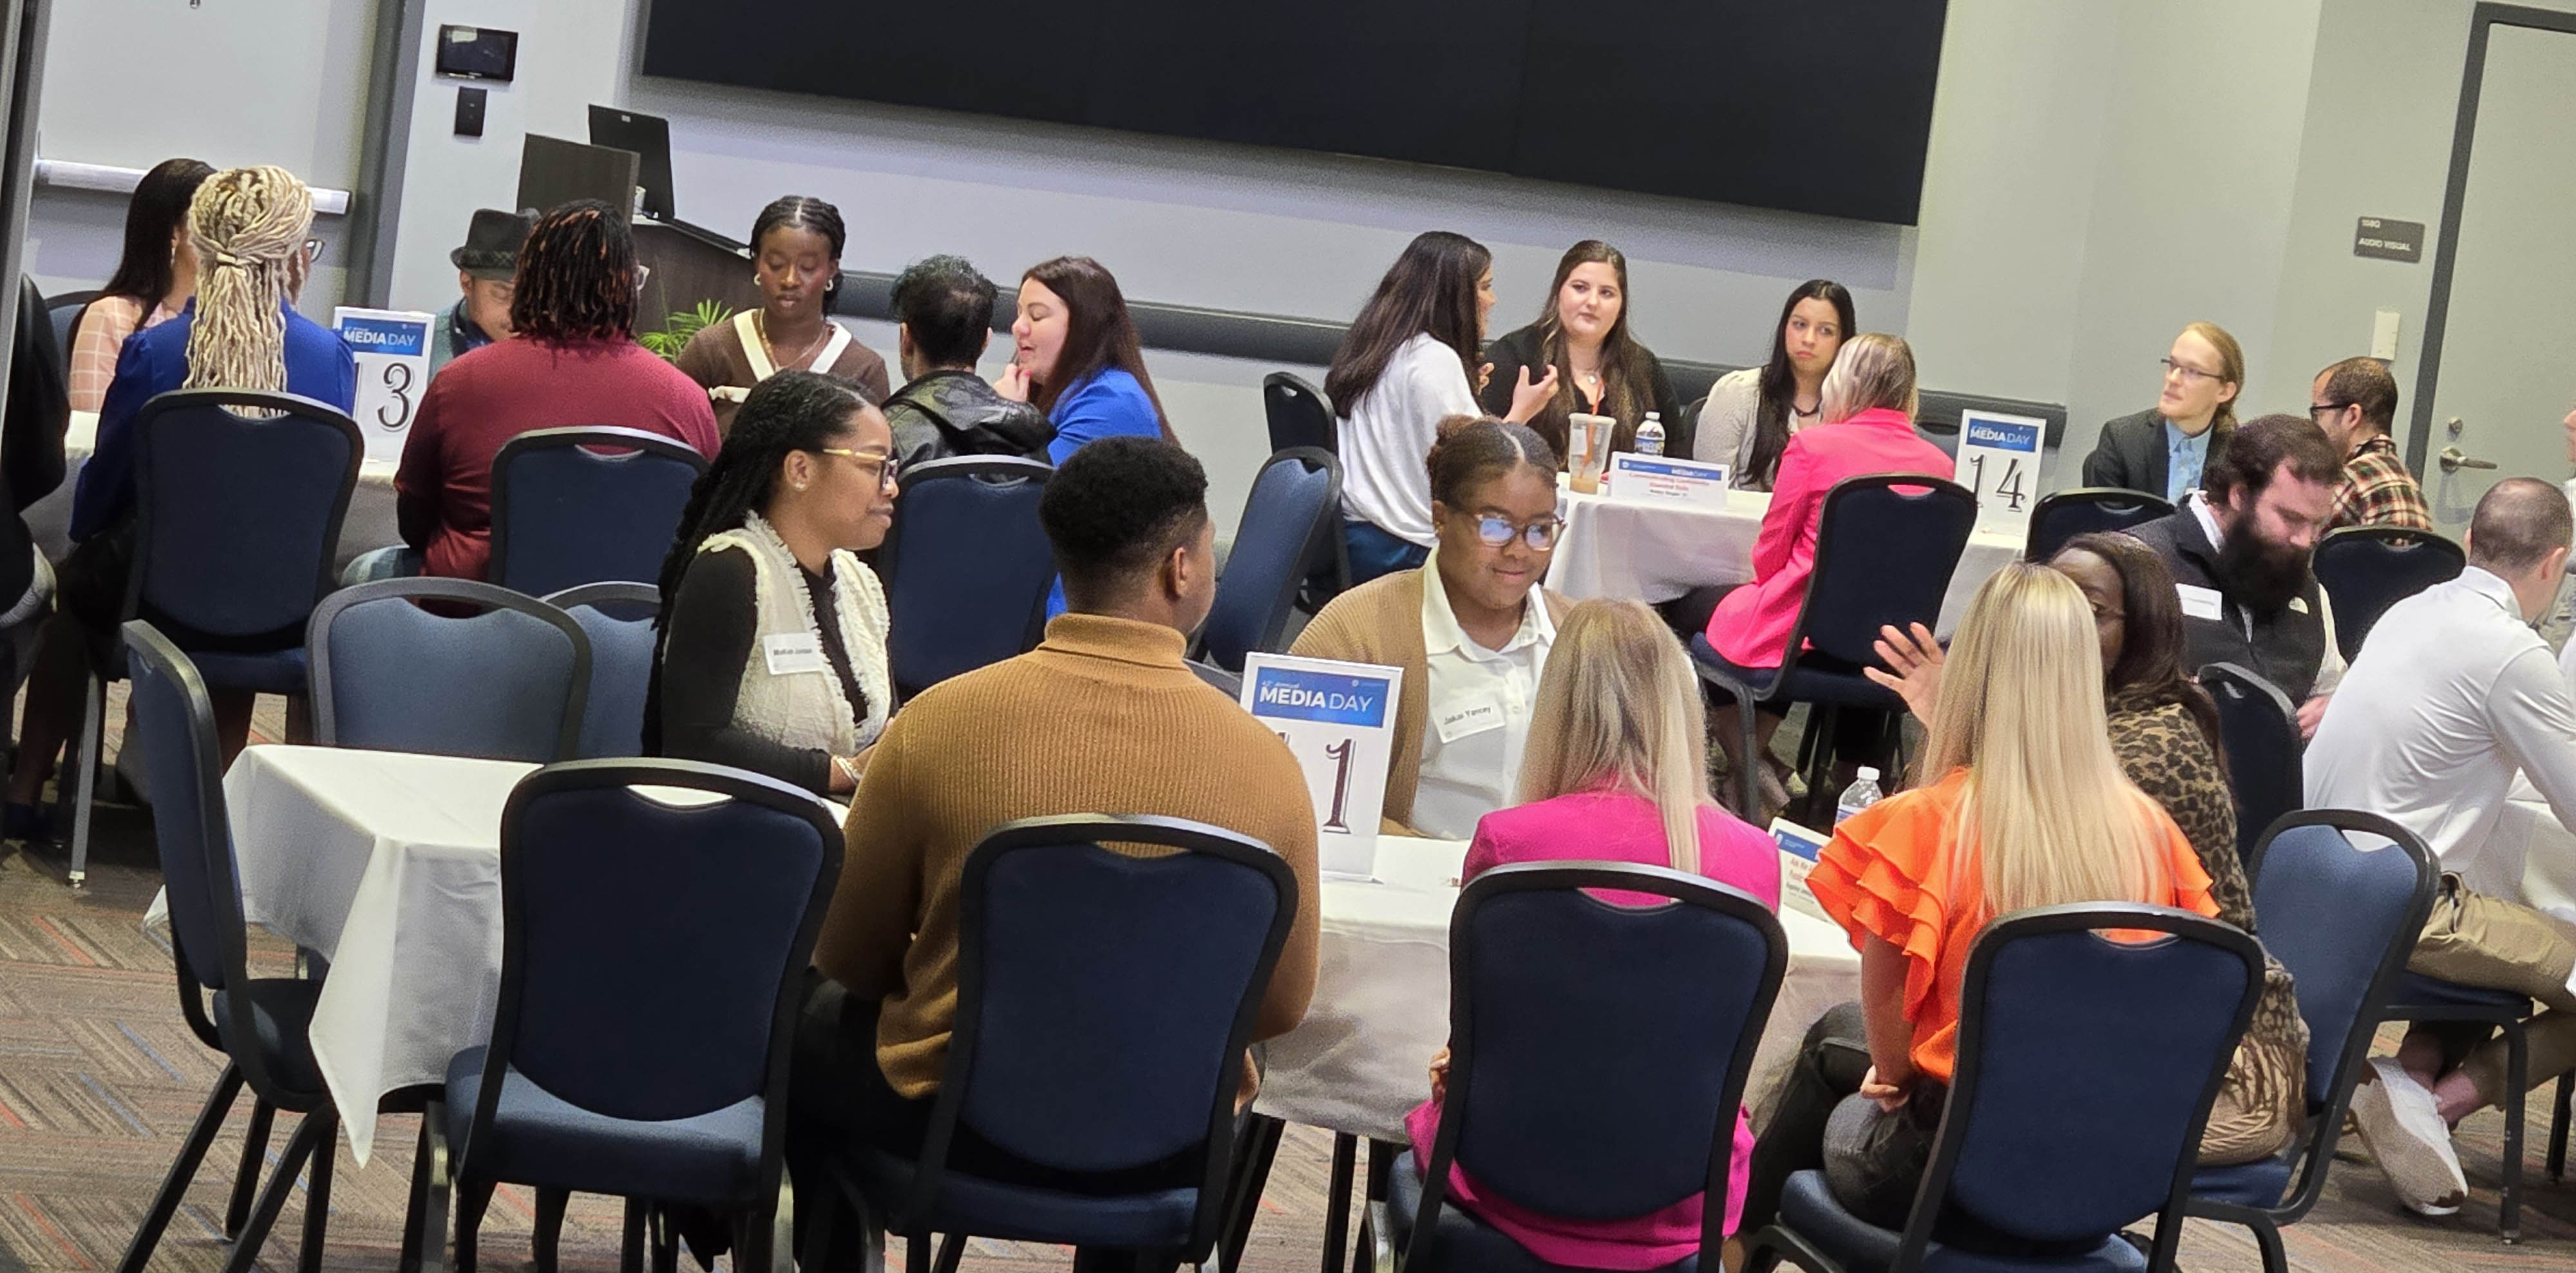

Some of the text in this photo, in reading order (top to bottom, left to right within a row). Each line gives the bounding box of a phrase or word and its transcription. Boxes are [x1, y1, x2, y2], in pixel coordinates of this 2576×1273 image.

[2358, 237, 2412, 251] AUDIO VISUAL
[343, 330, 415, 346] MEDIA DAY
[1969, 428, 2031, 445] MEDIA DAY
[1970, 454, 2025, 512] 14
[1259, 686, 1373, 713] MEDIA DAY
